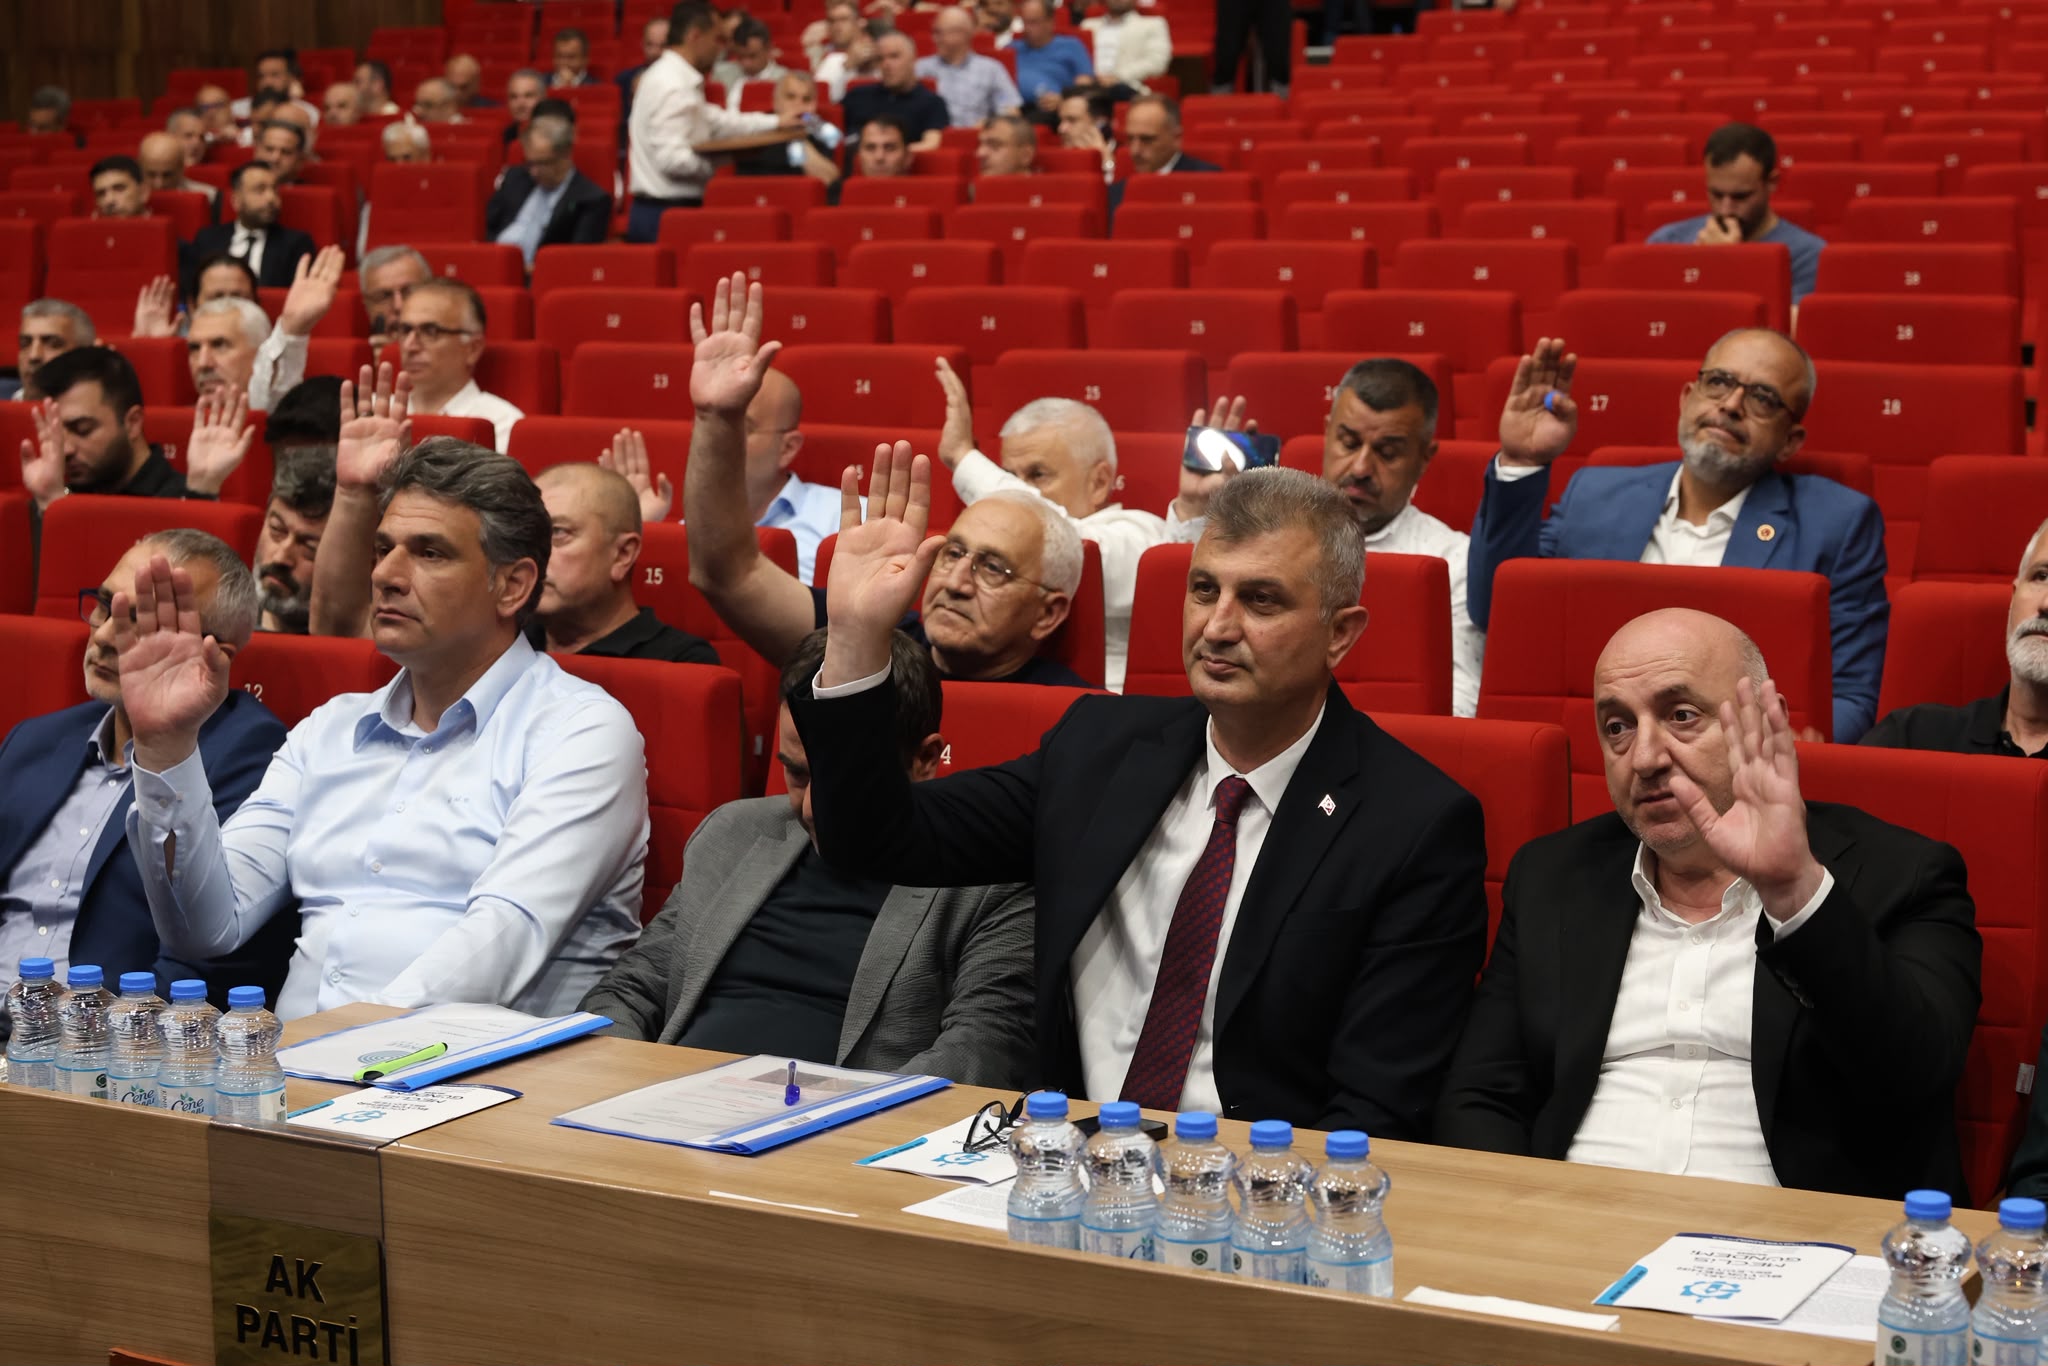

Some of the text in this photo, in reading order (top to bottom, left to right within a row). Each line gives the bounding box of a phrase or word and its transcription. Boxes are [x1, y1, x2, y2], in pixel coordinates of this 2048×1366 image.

[1648, 320, 1666, 336] 17
[653, 373, 669, 389] 13
[855, 379, 871, 394] 14
[1085, 384, 1101, 400] 15
[1589, 394, 1609, 411] 17
[1881, 398, 1901, 415] 18
[645, 567, 664, 585] 15
[265, 1253, 327, 1305] AK
[236, 1302, 359, 1366] PARTİ
